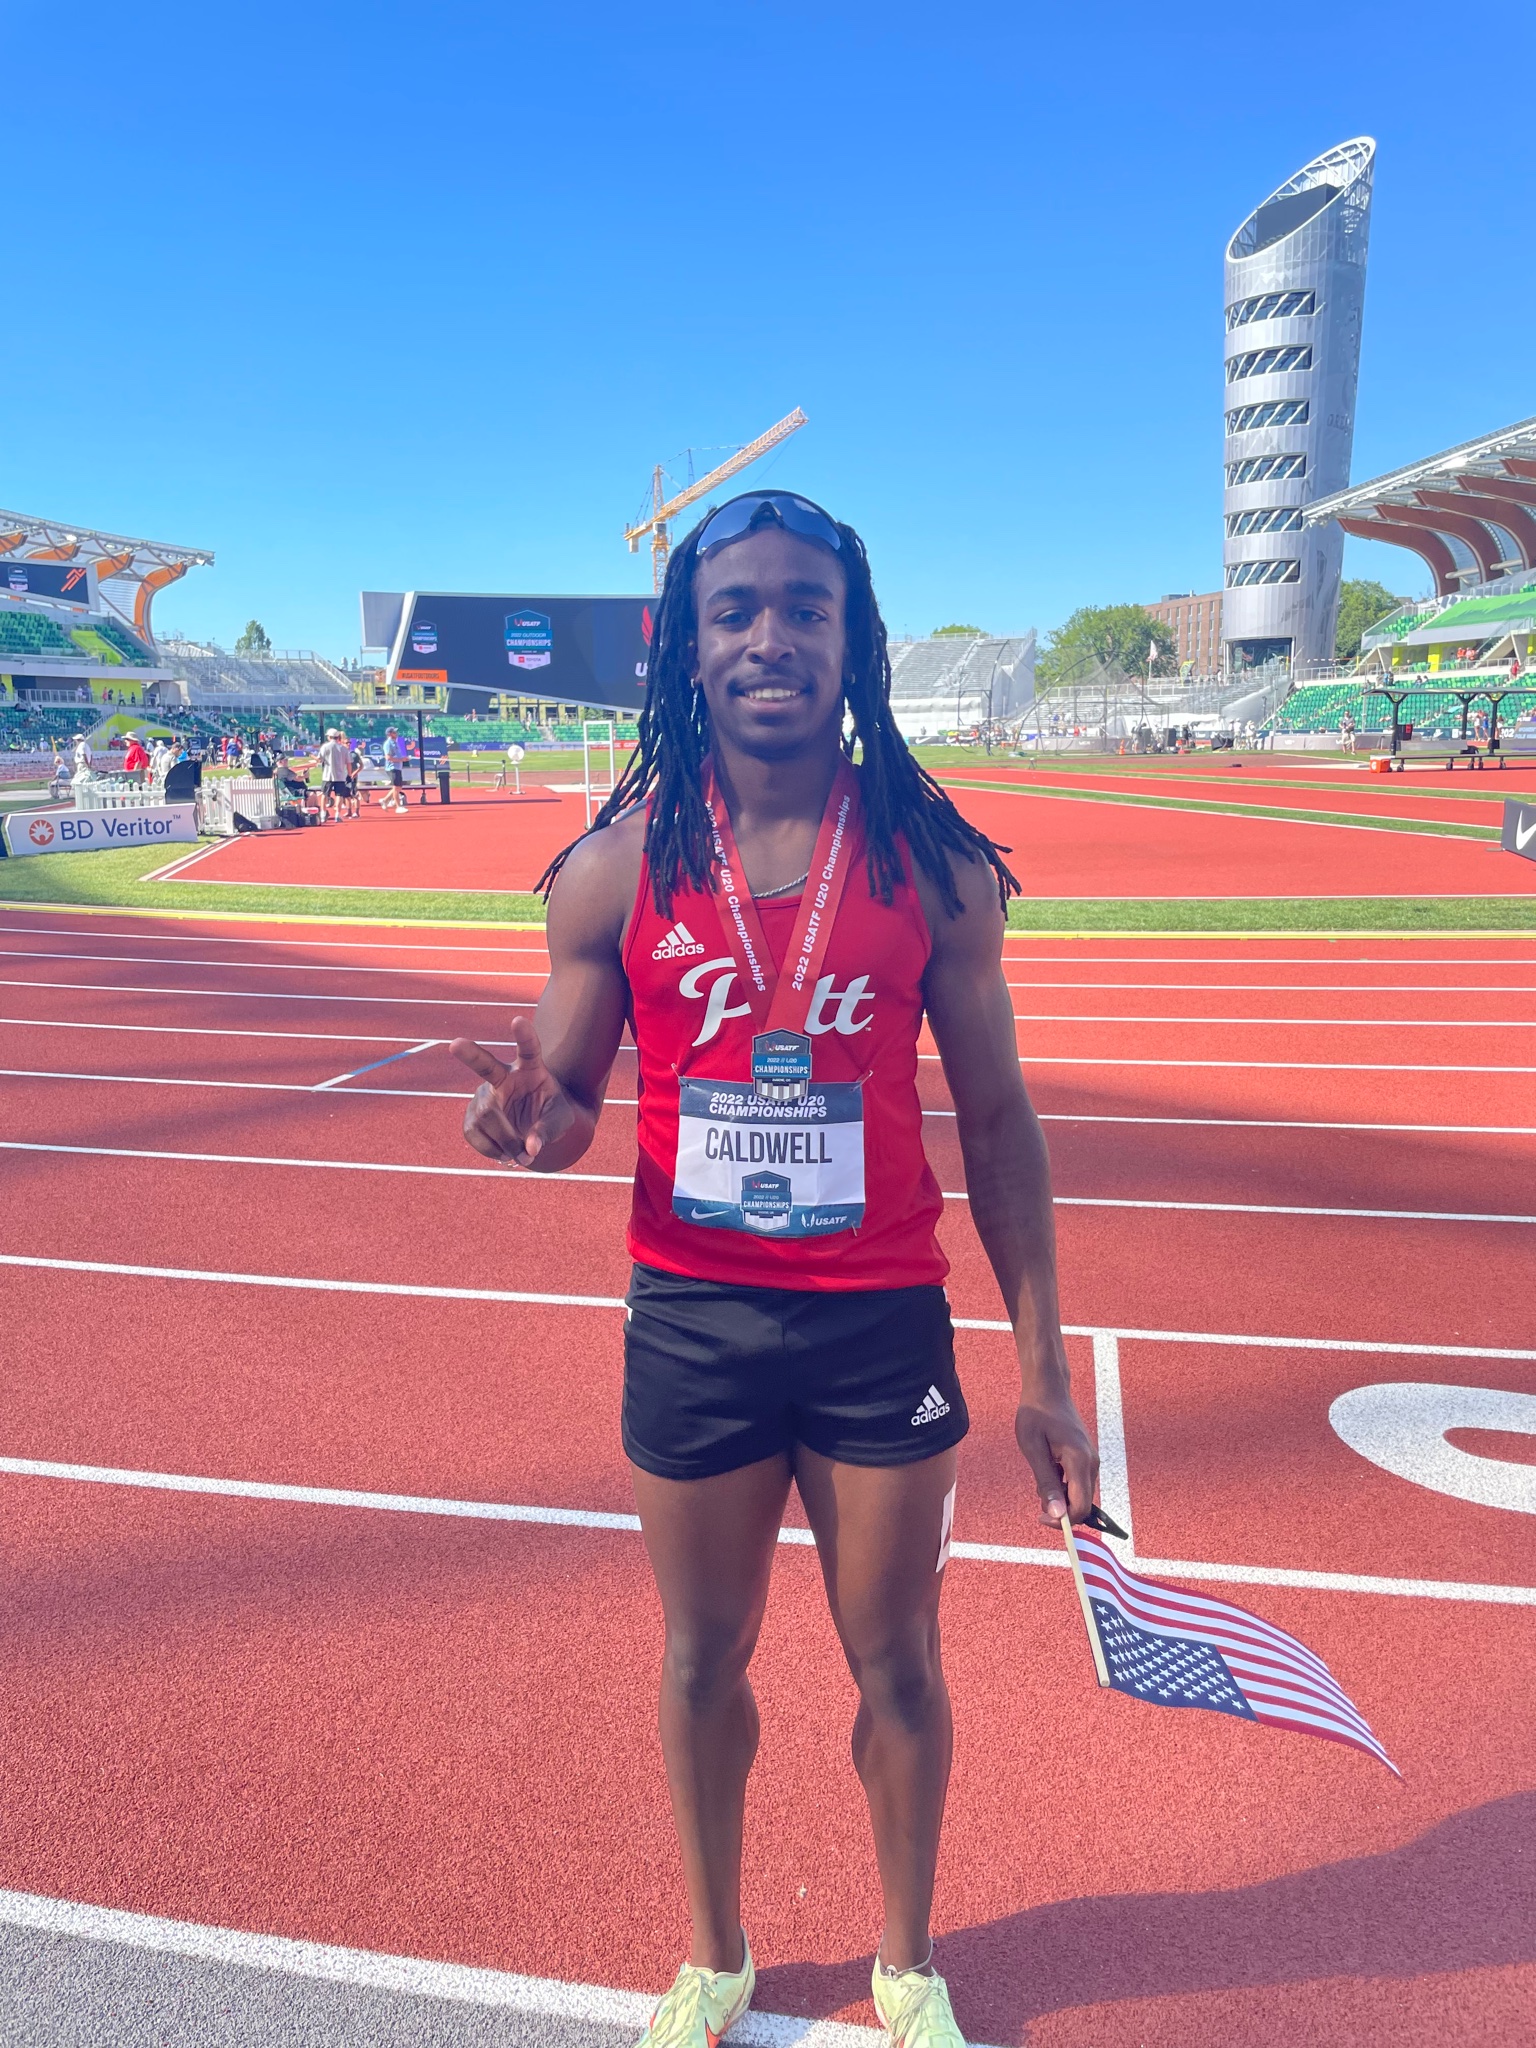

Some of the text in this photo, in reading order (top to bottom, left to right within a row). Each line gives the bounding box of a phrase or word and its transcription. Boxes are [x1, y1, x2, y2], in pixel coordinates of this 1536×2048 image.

[60, 820, 94, 841] BD
[720, 870, 735, 892] U20
[791, 794, 851, 992] 2022 USATF U20 Championships
[652, 942, 705, 961] adidas
[727, 894, 766, 992] Championships
[679, 957, 875, 1047] Ptt
[754, 1066, 808, 1074] CHAMPIONSHIPS
[711, 1092, 744, 1106] 2022
[798, 1095, 825, 1106] U20
[709, 1105, 827, 1118] CHAMPIONSHIPS
[706, 1127, 832, 1163] CALDWELL
[744, 1200, 789, 1208] CHAMPIONSHIPS
[816, 1216, 848, 1226] USATF
[911, 1402, 950, 1426] adidas
